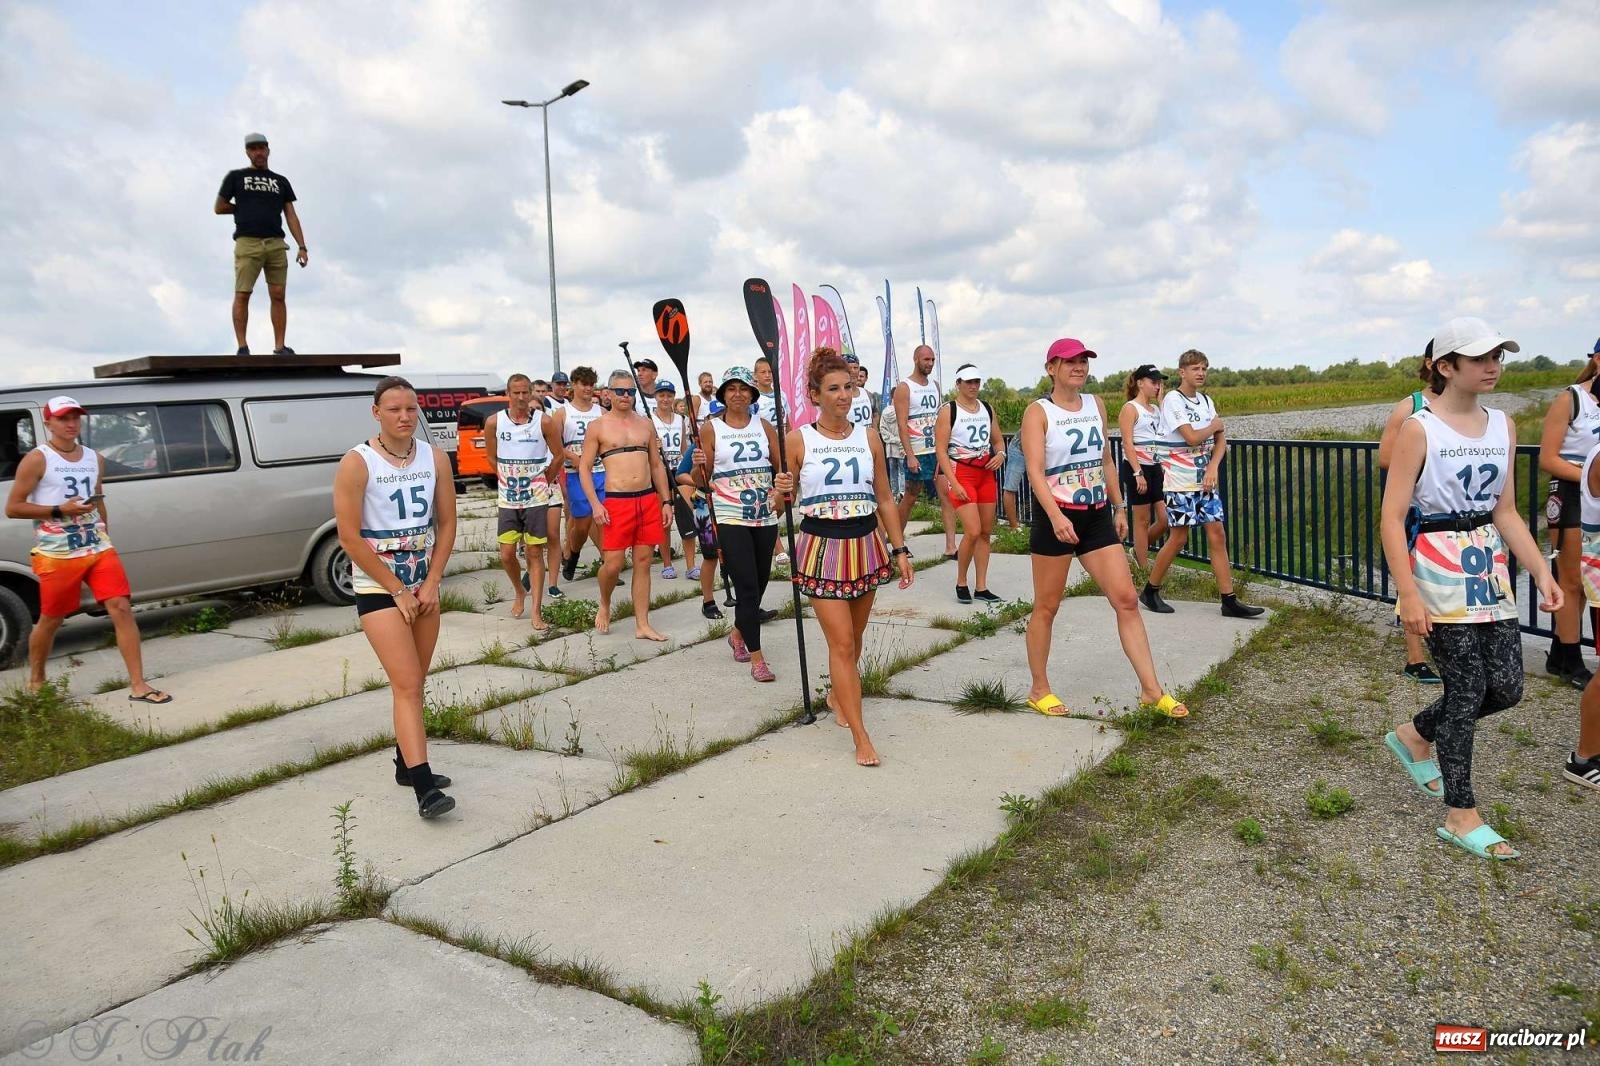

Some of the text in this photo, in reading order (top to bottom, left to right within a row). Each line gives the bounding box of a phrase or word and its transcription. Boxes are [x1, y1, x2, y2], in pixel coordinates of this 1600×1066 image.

[244, 184, 280, 193] PLASTIC
[921, 394, 937, 408] 40
[853, 405, 871, 423] 50
[1187, 412, 1200, 422] 28
[500, 431, 512, 441] 43
[663, 432, 681, 447] 16
[966, 424, 988, 443] 26
[1066, 426, 1102, 455] 24
[730, 441, 762, 463] 23
[812, 445, 866, 454] #odrasupcup
[376, 471, 431, 484] #odrasupcup
[822, 457, 860, 486] 21
[63, 476, 91, 498] 31
[1456, 463, 1499, 501] 12
[389, 485, 428, 520] 15
